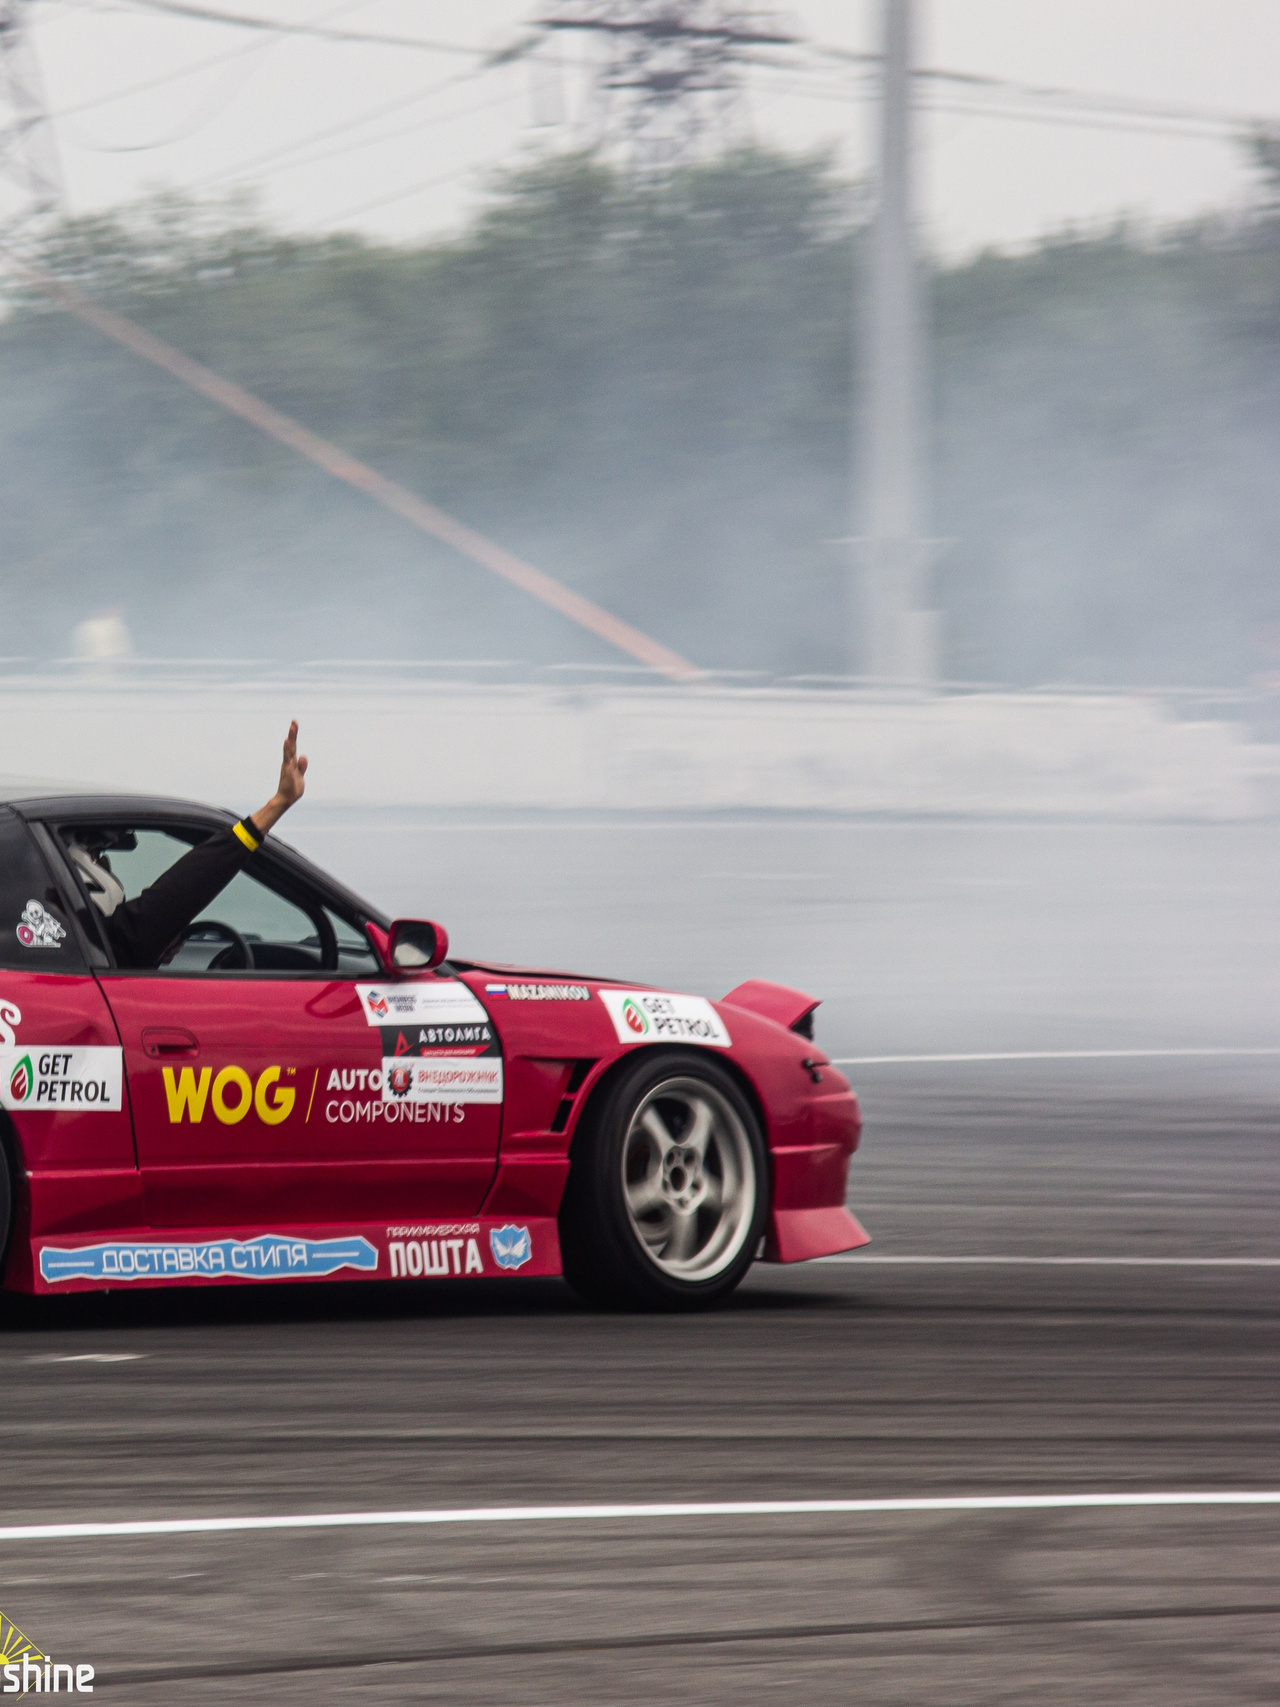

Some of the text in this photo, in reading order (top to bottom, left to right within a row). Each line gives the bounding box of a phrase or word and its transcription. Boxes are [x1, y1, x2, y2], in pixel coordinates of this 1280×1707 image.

[642, 996, 676, 1015] GET
[419, 1027, 491, 1043] АВТОЛИГА
[654, 1017, 720, 1040] PETROL
[38, 1054, 73, 1076] GET
[36, 1080, 111, 1102] PETROL
[327, 1068, 382, 1091] AUTO
[162, 1065, 296, 1125] WOG
[325, 1100, 465, 1123] COMPONENTS
[102, 1247, 225, 1273] ДОСТАВКА
[389, 1238, 484, 1277] ПОШТА
